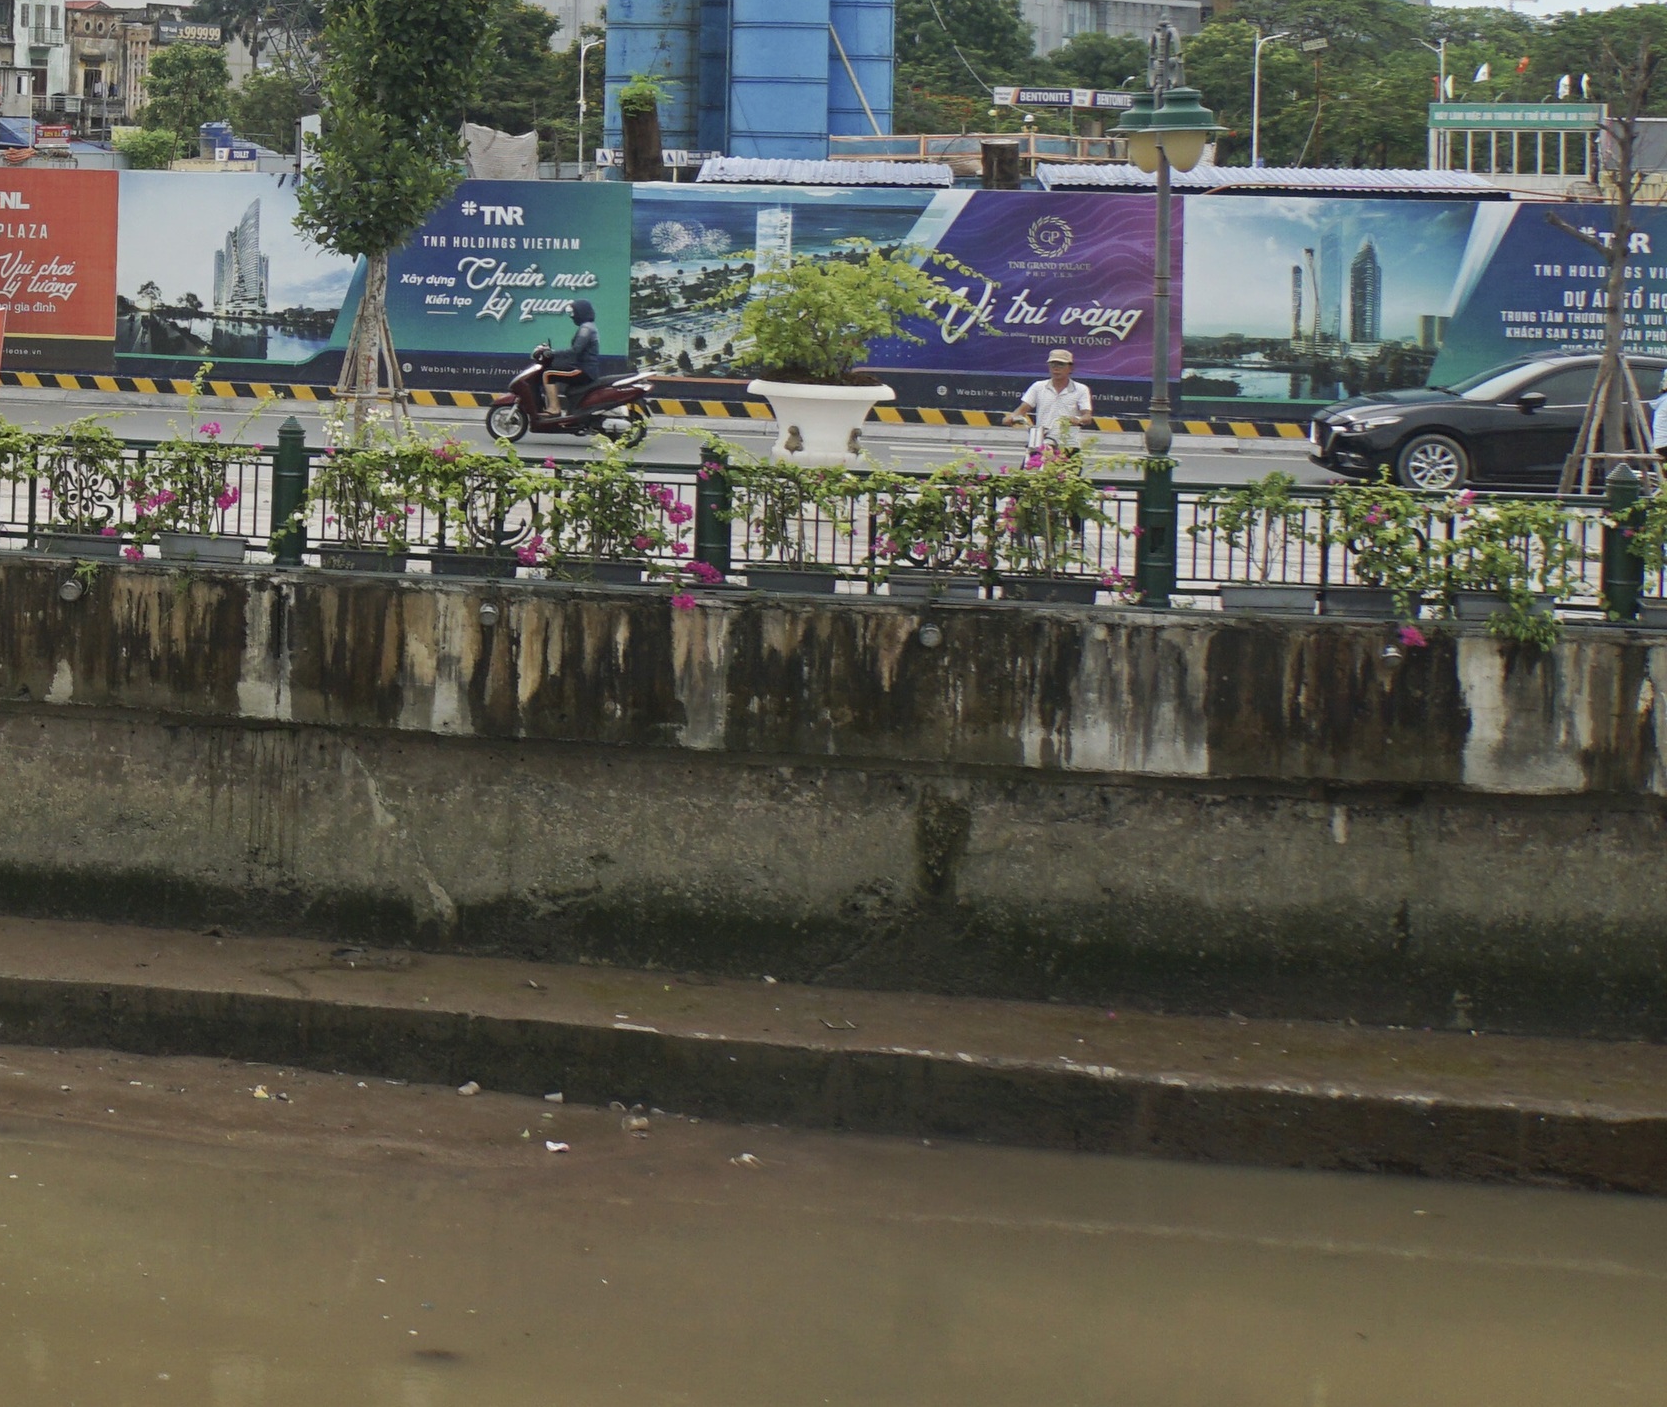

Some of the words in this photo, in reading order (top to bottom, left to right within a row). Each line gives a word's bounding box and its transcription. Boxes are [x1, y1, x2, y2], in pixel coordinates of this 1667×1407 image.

[1020, 91, 1070, 103] BENTONITE
[1096, 93, 1132, 107] BENTONITE
[479, 205, 525, 226] TNR
[422, 235, 447, 247] TNR
[453, 236, 517, 249] HOLDINGS
[522, 237, 581, 250] VIETNAM
[1598, 232, 1652, 255] TR
[37, 255, 77, 278] chơi
[1026, 261, 1058, 271] GRAND
[1058, 262, 1091, 272] PALACE
[1534, 264, 1563, 278] TNR
[1568, 265, 1643, 279] HOLDGS
[400, 273, 424, 286] Xây
[425, 274, 456, 288] dựng
[551, 270, 599, 292] mực
[1563, 290, 1587, 311] DỰ
[1623, 285, 1645, 309] TỔ
[14, 302, 30, 315] gia
[32, 301, 57, 313] đình
[425, 293, 451, 305] Kiến
[452, 296, 473, 308] tạo
[519, 297, 575, 323] quan
[1004, 288, 1053, 325] trí
[1059, 299, 1144, 342] vàng
[1500, 310, 1537, 323] TRUNG
[1540, 309, 1564, 324] TÂM
[1643, 314, 1663, 326] VUI
[1028, 334, 1067, 346] THỊNH
[1070, 335, 1112, 347] VƯỢNG
[1505, 325, 1543, 339] KHÁCH
[1546, 328, 1568, 341] SẠN
[1571, 328, 1579, 339] 5
[420, 365, 460, 374] Website:
[956, 387, 998, 397] Website:
